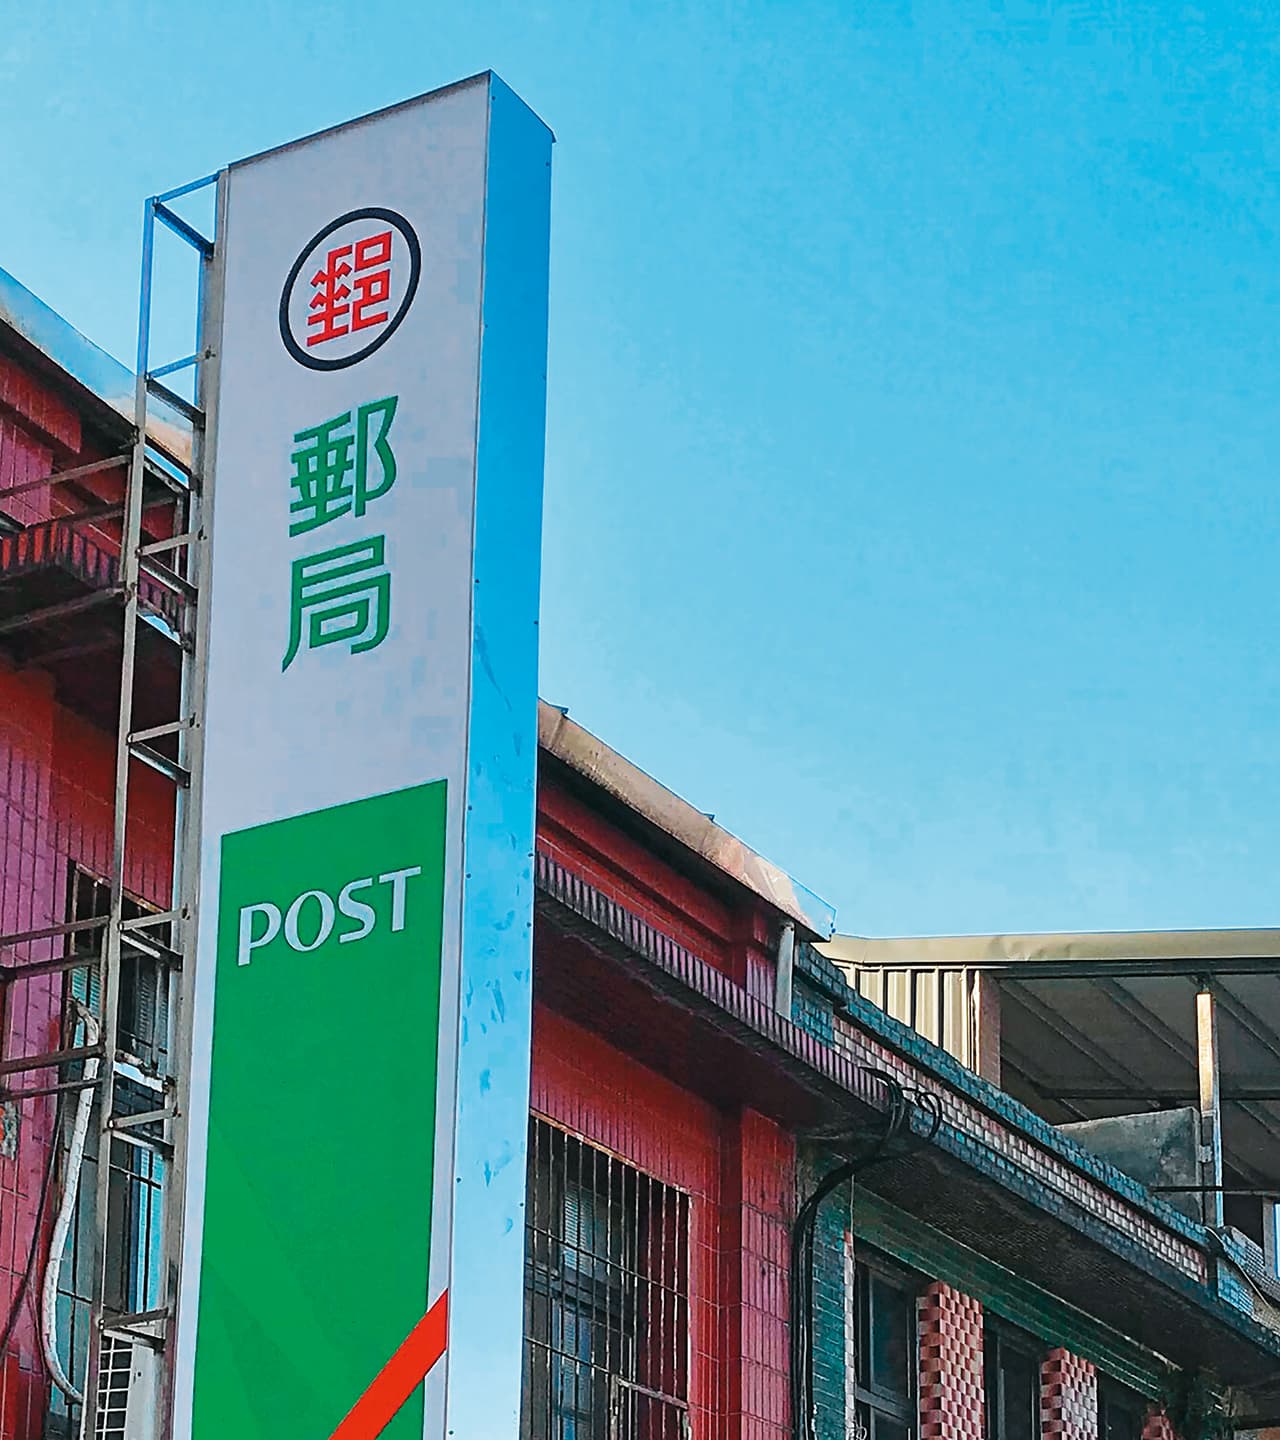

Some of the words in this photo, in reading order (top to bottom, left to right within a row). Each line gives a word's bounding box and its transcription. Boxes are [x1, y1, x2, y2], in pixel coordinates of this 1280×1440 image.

[307, 231, 393, 347] 郵
[283, 394, 399, 673] 郵局
[237, 866, 422, 968] POST
